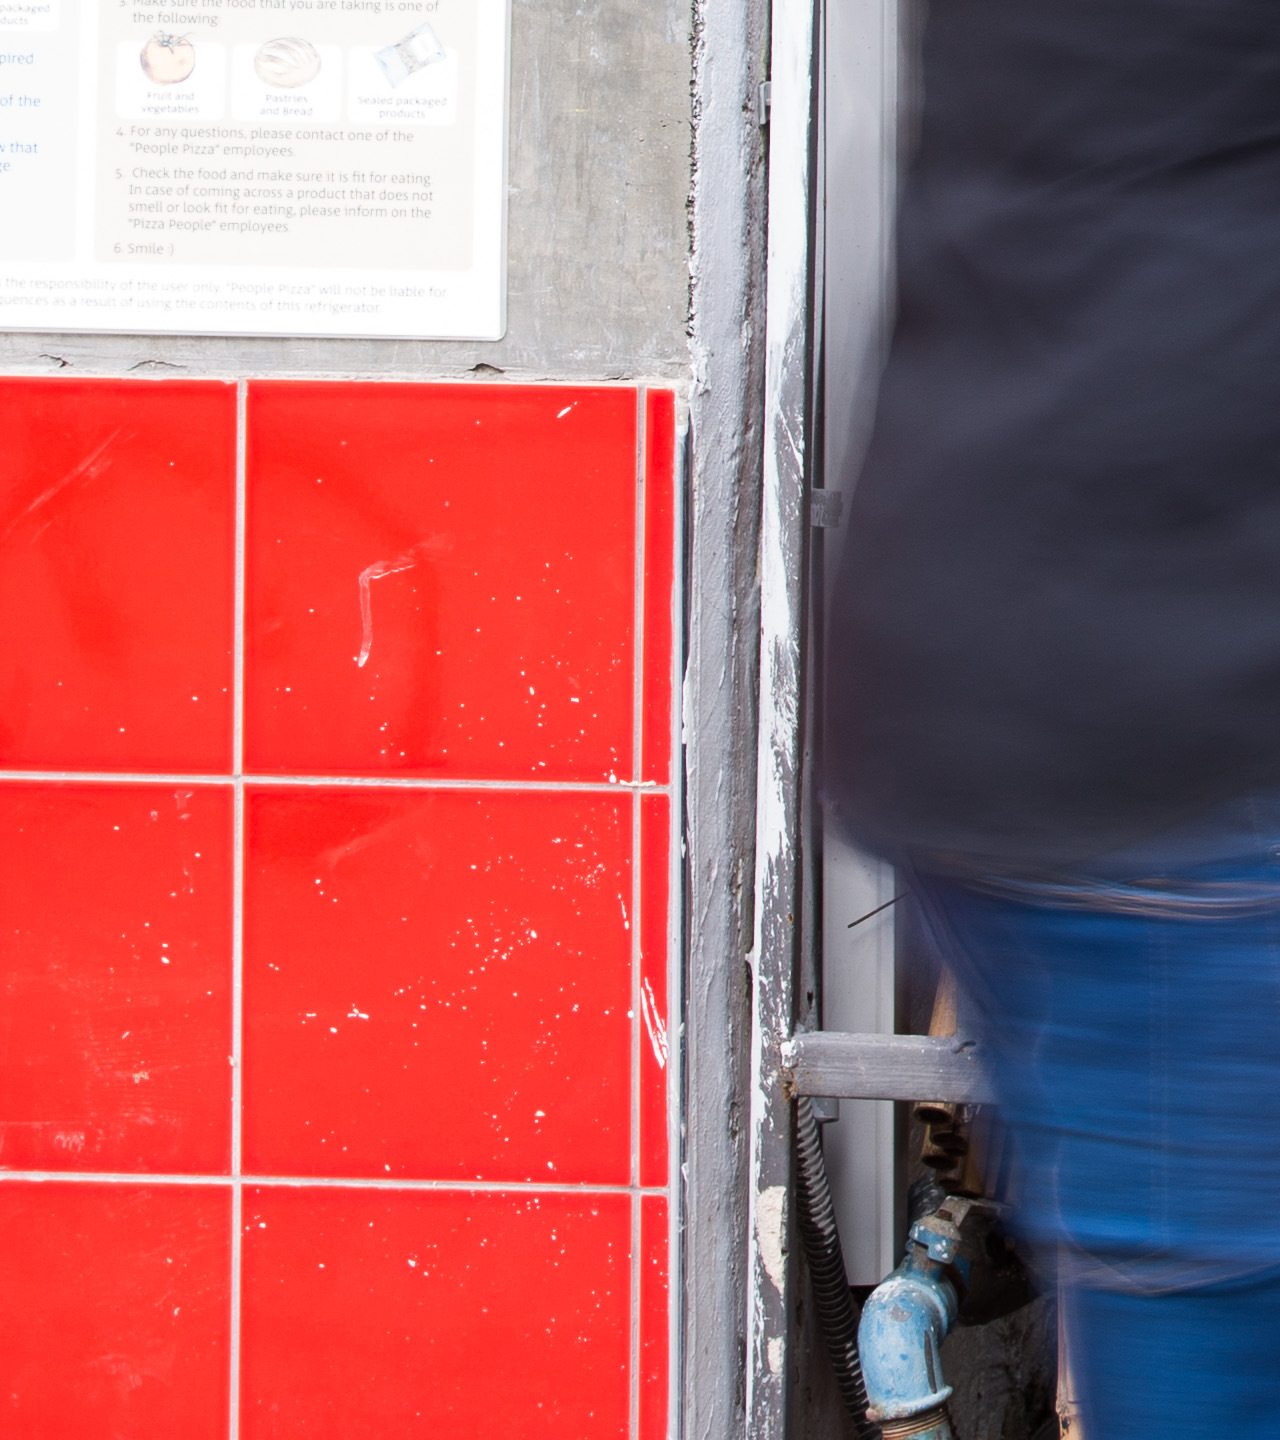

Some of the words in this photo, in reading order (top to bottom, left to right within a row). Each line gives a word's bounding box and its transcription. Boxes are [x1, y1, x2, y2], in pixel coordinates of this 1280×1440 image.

[290, 0, 313, 11] you
[316, 0, 337, 10] are
[341, 0, 381, 14] taking
[384, 0, 395, 11] is
[398, 2, 423, 12] one
[426, 0, 439, 12] of
[133, 12, 154, 23] the
[130, 125, 151, 137] For
[154, 127, 178, 139] any
[250, 127, 293, 140] please
[295, 130, 344, 141] contact
[347, 131, 373, 142] one
[375, 129, 389, 142] of
[392, 130, 415, 143] the
[130, 142, 179, 156] "People
[182, 143, 220, 155] Pizza"
[128, 243, 164, 255] Smile
